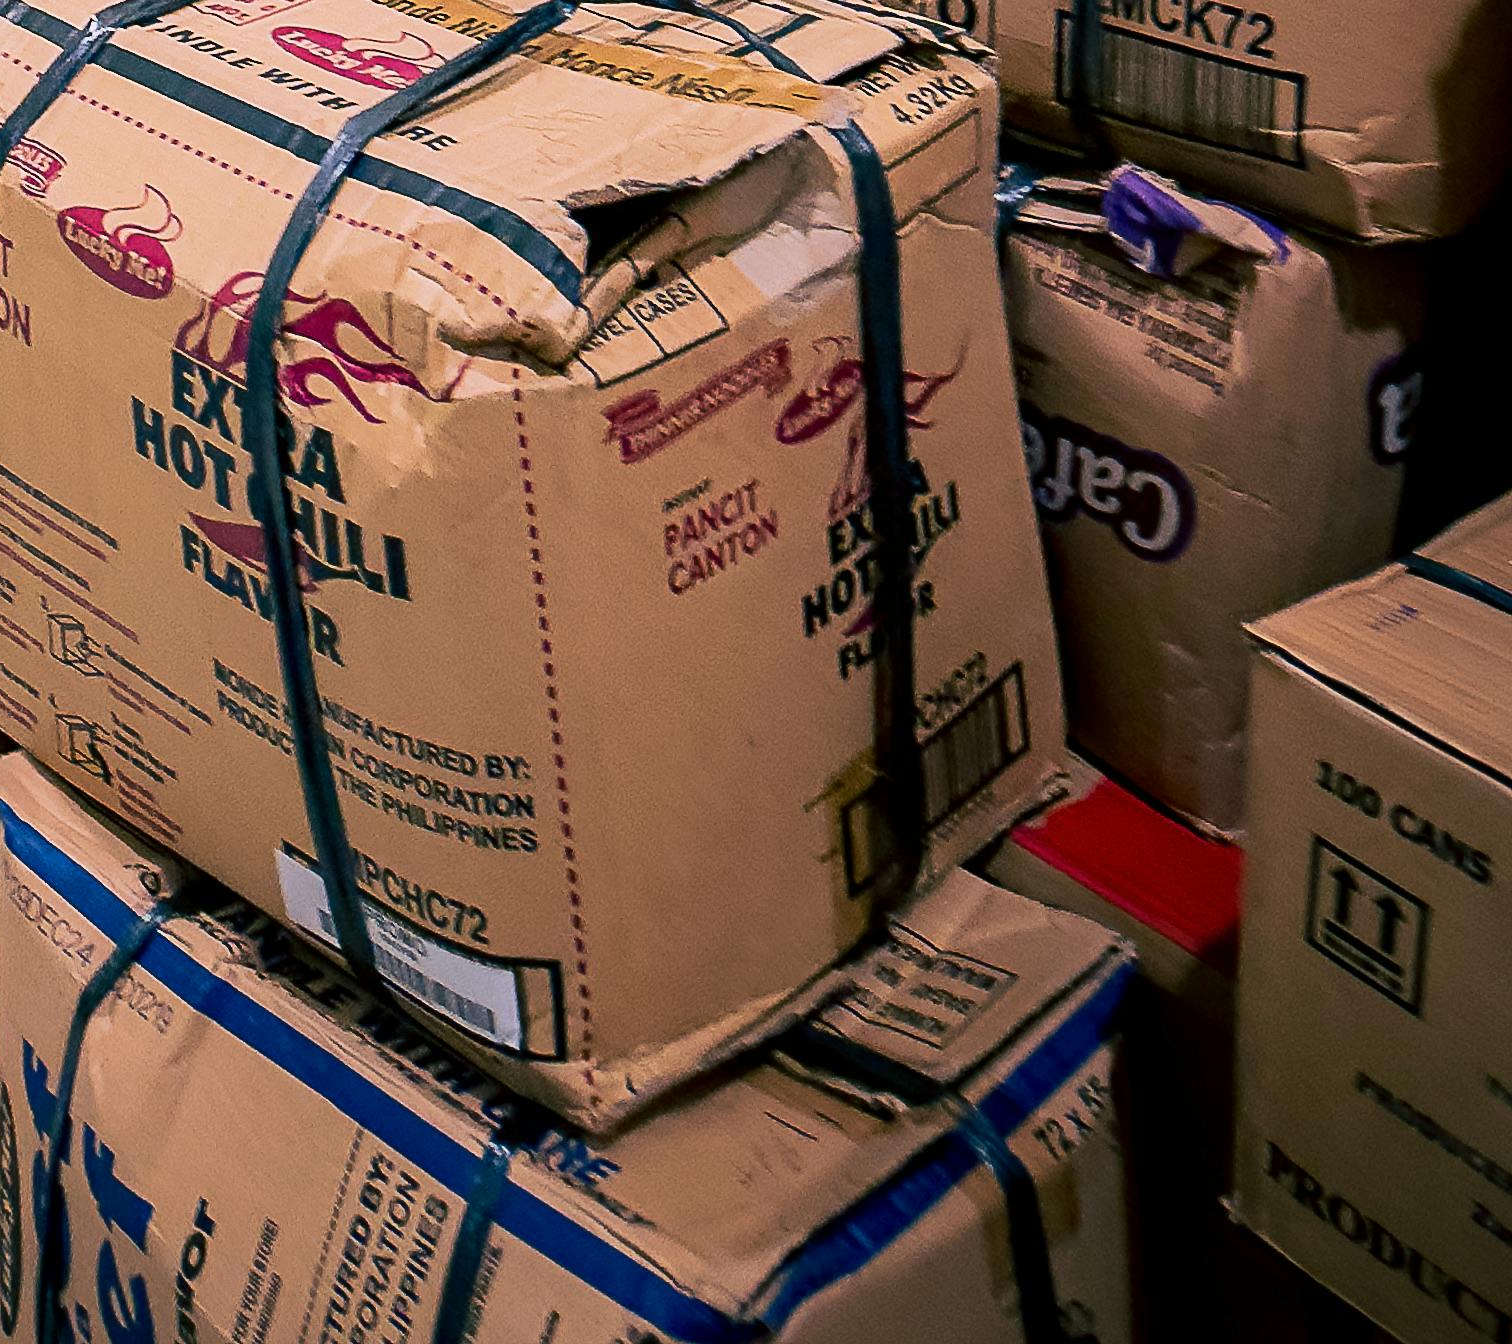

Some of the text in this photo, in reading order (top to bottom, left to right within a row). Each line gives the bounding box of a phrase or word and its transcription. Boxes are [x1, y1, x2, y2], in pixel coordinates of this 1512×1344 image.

[275, 30, 361, 70] Lucky
[258, 67, 361, 111] WITH
[64, 216, 168, 291] Lucky Me!
[633, 280, 699, 324] CASES
[131, 394, 238, 512] HOT
[664, 478, 761, 557] PANCIT
[666, 509, 779, 596] CANTON
[179, 522, 345, 668] FLAVR
[215, 689, 297, 757] PRODUC
[380, 791, 541, 854] PHILIPPINES
[349, 746, 536, 820] CORPORATION
[484, 753, 532, 781] BY:
[1316, 758, 1495, 888] 100 CANS
